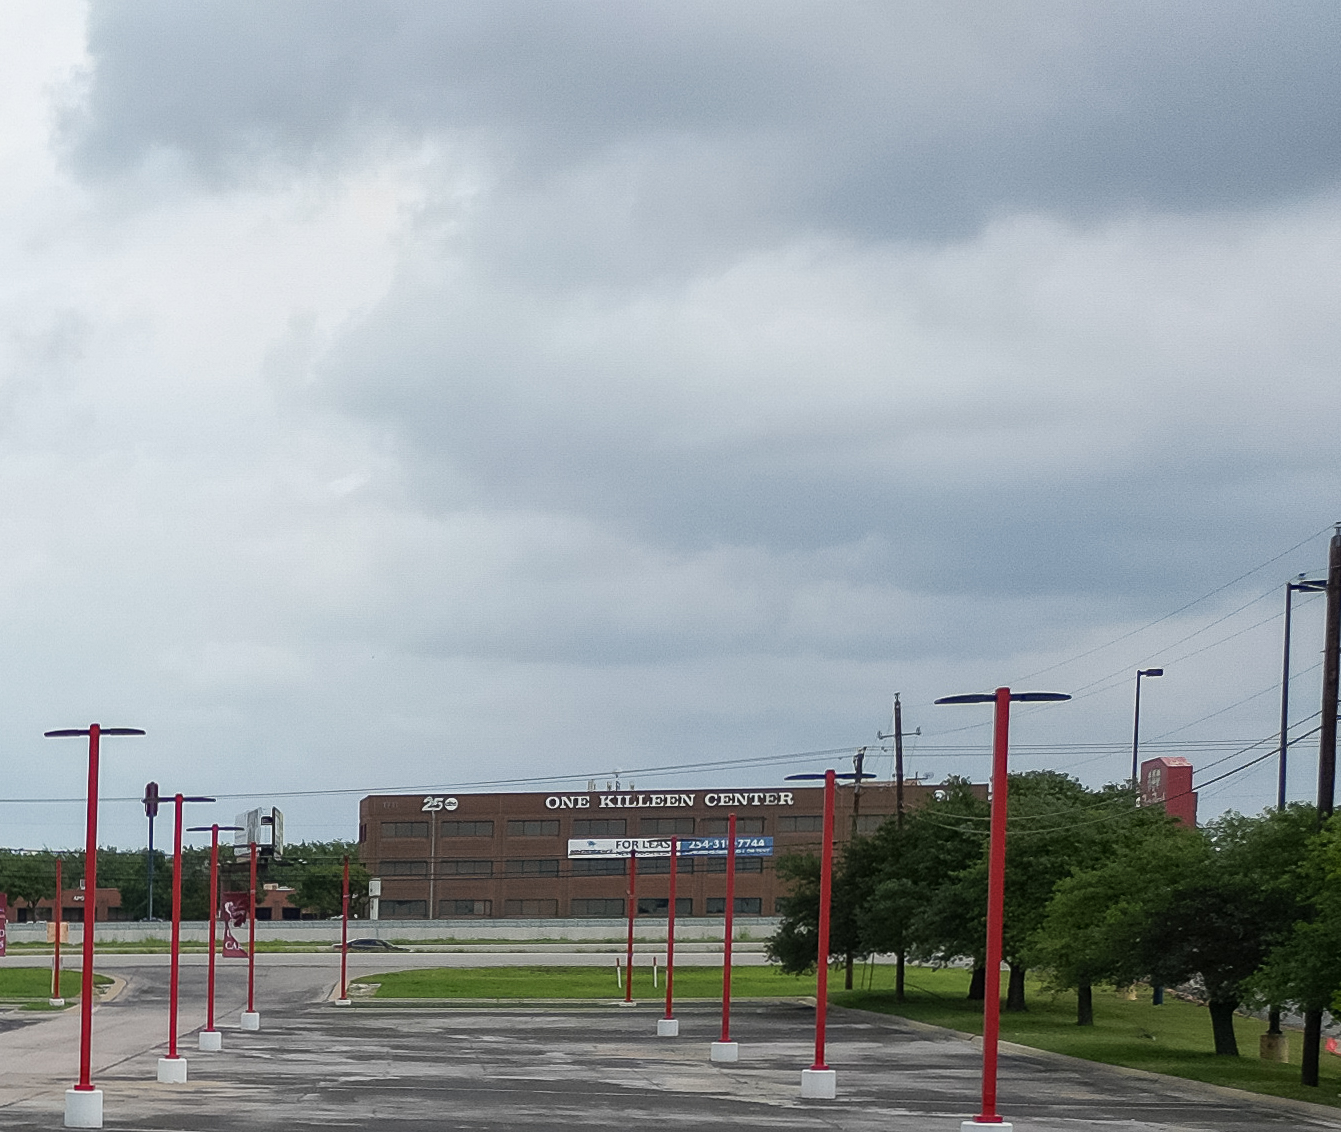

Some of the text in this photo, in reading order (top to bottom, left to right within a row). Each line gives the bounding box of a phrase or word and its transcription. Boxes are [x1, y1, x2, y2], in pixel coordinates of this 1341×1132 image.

[545, 792, 794, 809] ONE KILLEEN CENTER
[615, 840, 679, 849] FOR LEAS
[689, 839, 765, 849] 254-31-7744
